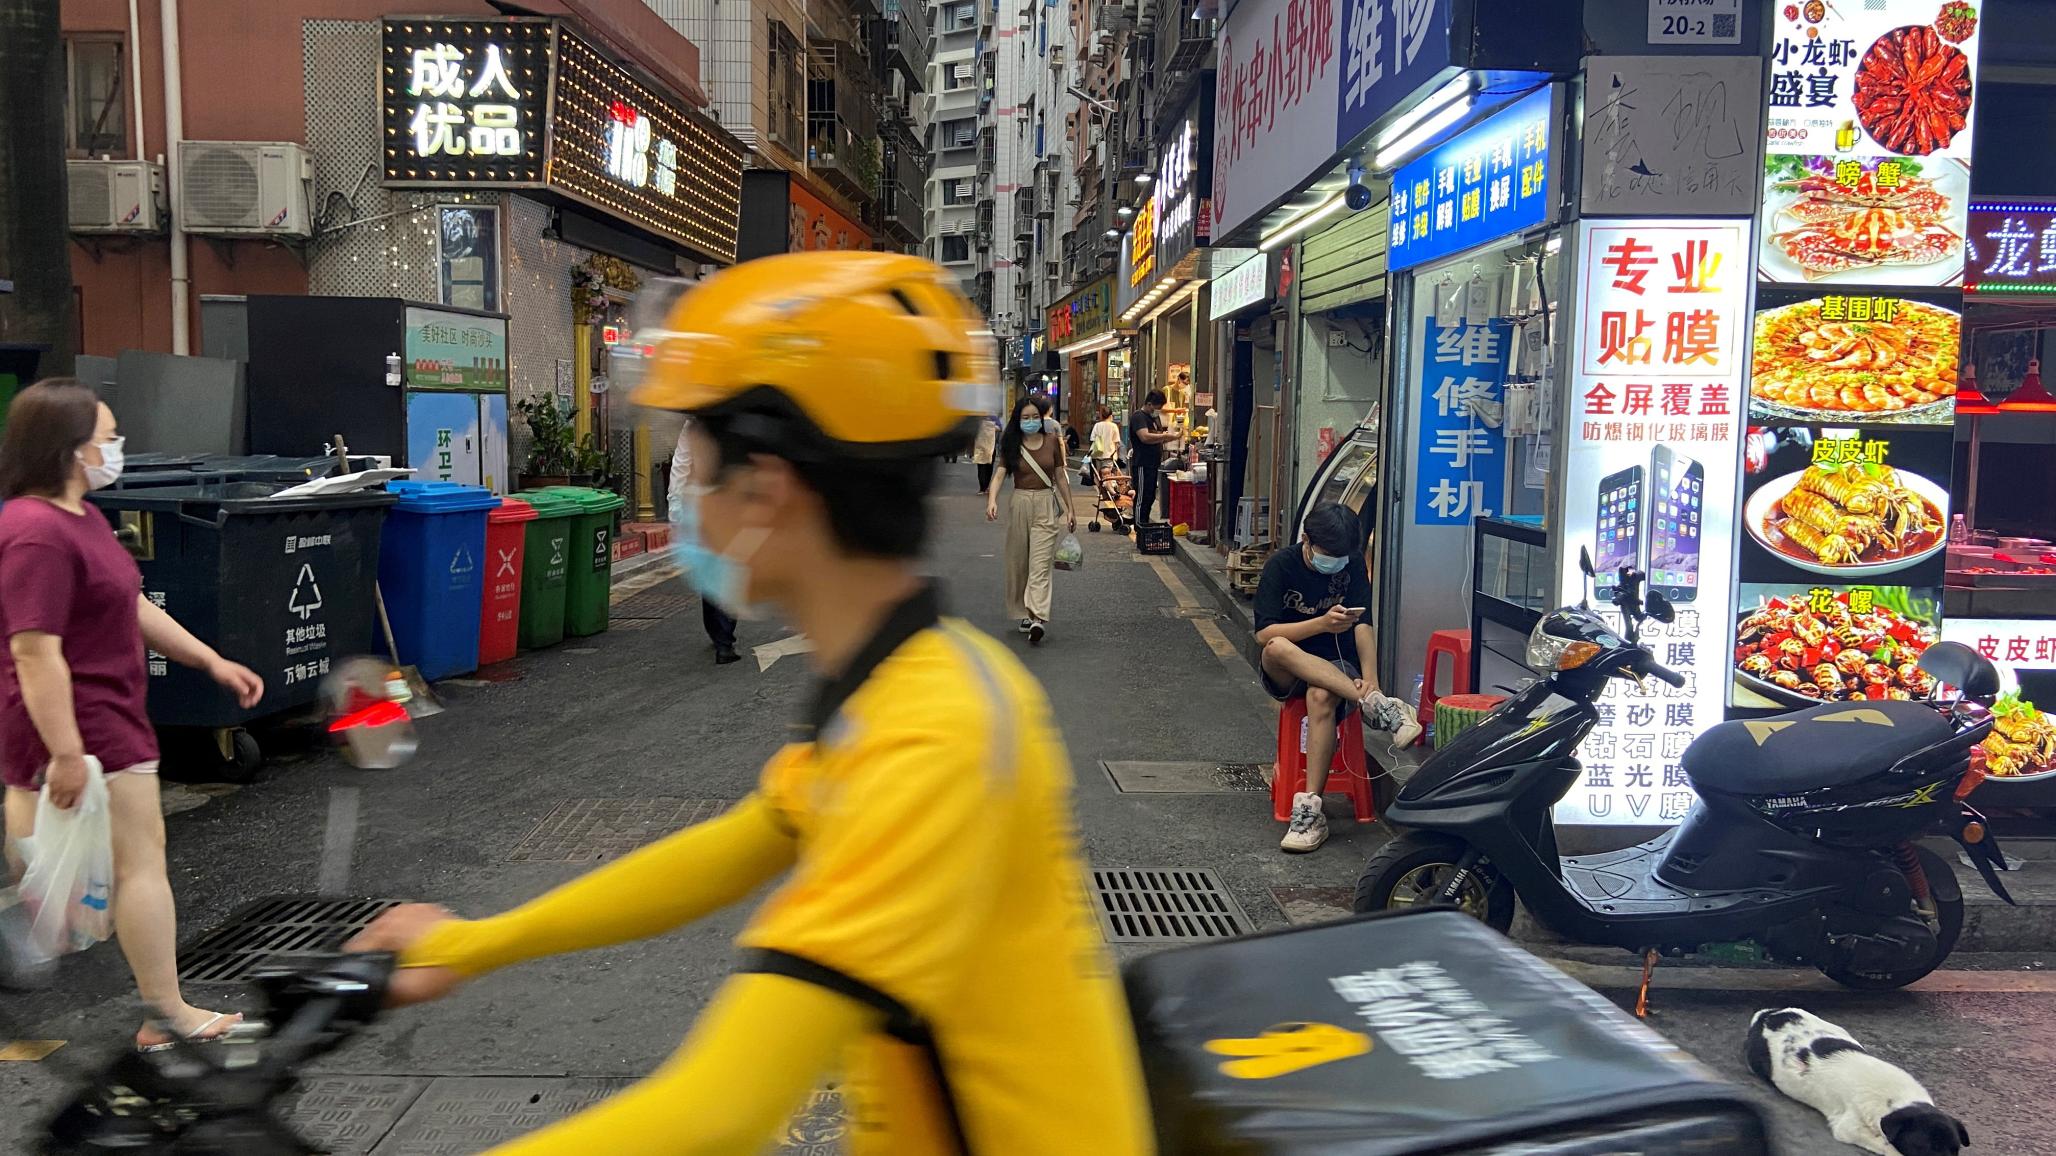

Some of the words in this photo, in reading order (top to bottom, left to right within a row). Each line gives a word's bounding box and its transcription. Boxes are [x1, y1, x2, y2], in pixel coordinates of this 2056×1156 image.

[1662, 16, 1705, 35] 20-2
[1772, 36, 1857, 67] 小龙虾
[411, 43, 521, 99] 成人
[1768, 68, 1839, 108] 盛宴
[411, 103, 521, 157] 优品
[1521, 160, 1545, 199] 配件
[1835, 160, 1901, 187] 螃蟹
[1601, 238, 1723, 296] 专业
[1820, 296, 1899, 323] 基围虾
[1596, 308, 1720, 366] 贴膜
[1584, 382, 1731, 416] 全屏覆盖
[1427, 326, 1501, 518] 维修手机
[1582, 421, 1729, 442] 防爆钢化玻璃膜
[1810, 438, 1889, 465] 皮皮虾
[1808, 587, 1873, 614] 花螺
[286, 623, 326, 645] 其他垃圾
[1978, 634, 2056, 664] 皮皮虾
[1584, 731, 1694, 760] 钻石膜
[1584, 763, 1690, 788] 蓝光膜
[1765, 796, 1808, 809] YAMAHA
[1444, 868, 1468, 897] YAMAHA
